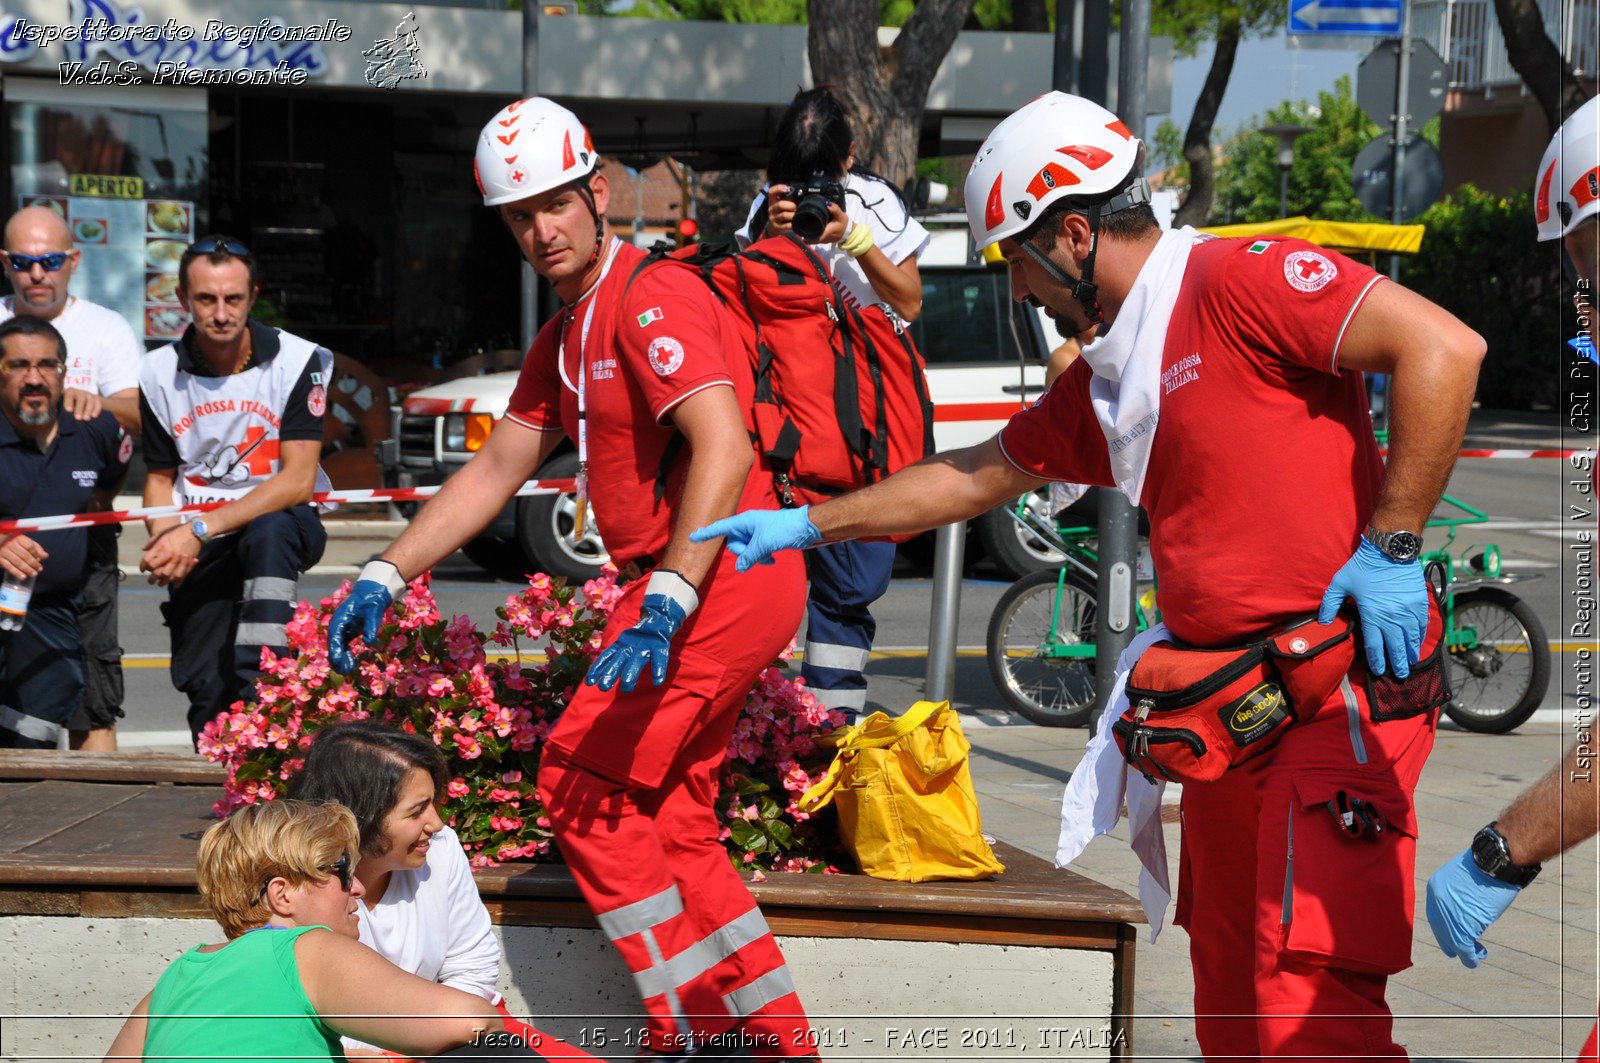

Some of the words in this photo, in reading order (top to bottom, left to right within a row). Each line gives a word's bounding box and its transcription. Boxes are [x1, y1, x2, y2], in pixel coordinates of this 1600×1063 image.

[76, 178, 138, 195] APERTO
[1179, 352, 1202, 372] ROSSA
[1166, 368, 1199, 395] ITALIANA
[195, 399, 236, 417] ROSSA
